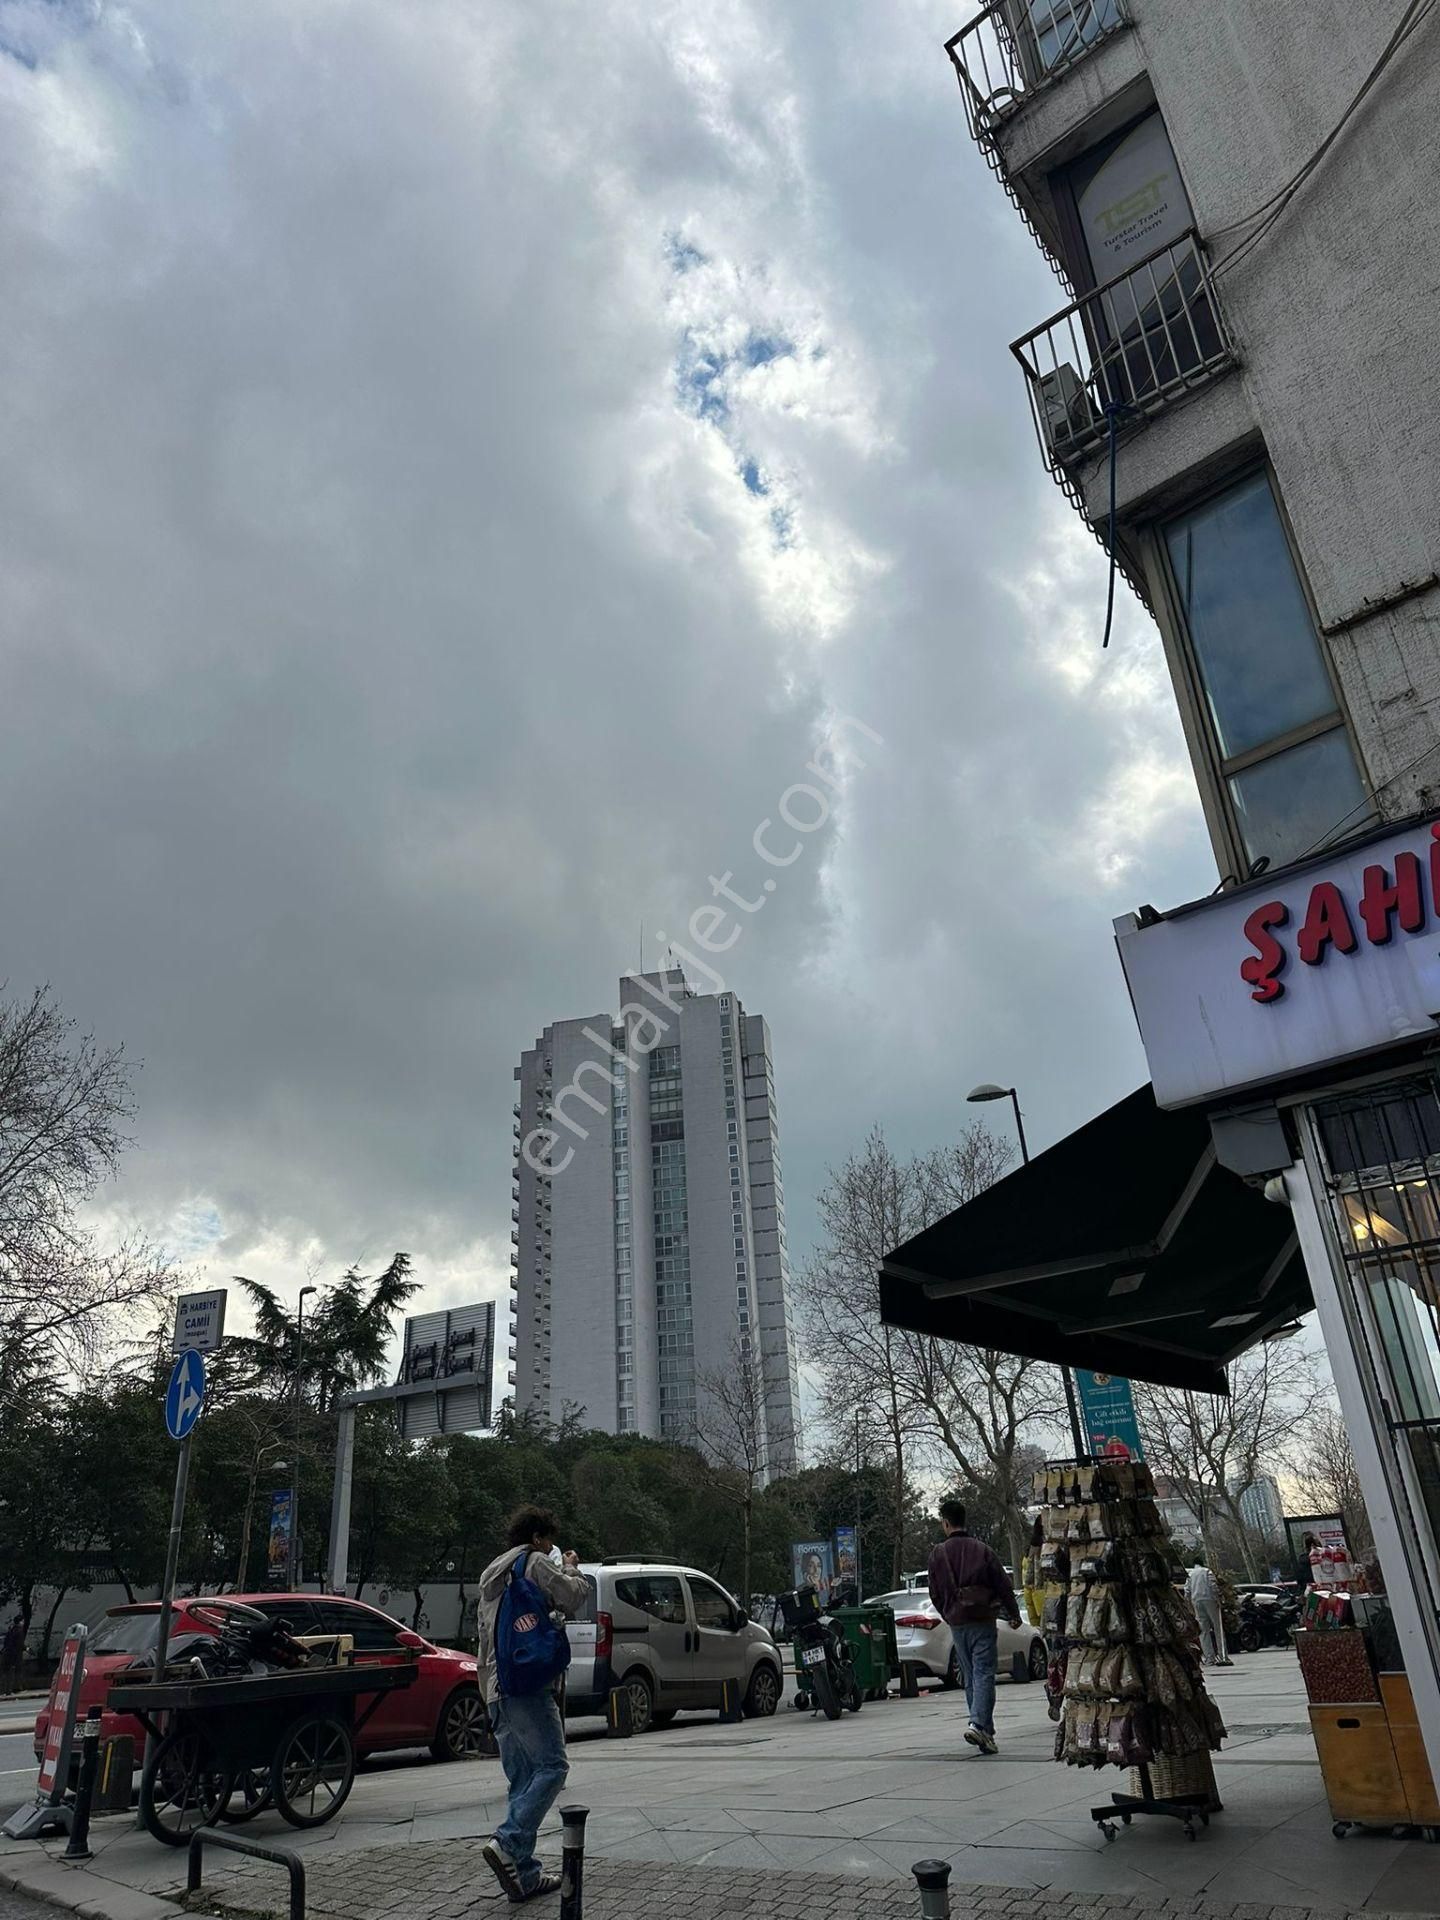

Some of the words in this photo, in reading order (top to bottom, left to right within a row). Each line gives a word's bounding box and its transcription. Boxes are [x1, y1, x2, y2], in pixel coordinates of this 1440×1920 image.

[1103, 223, 1138, 247] Turstar
[1138, 203, 1168, 225] Travel
[1123, 219, 1162, 245] Tourism
[514, 1613, 538, 1632] VANS
